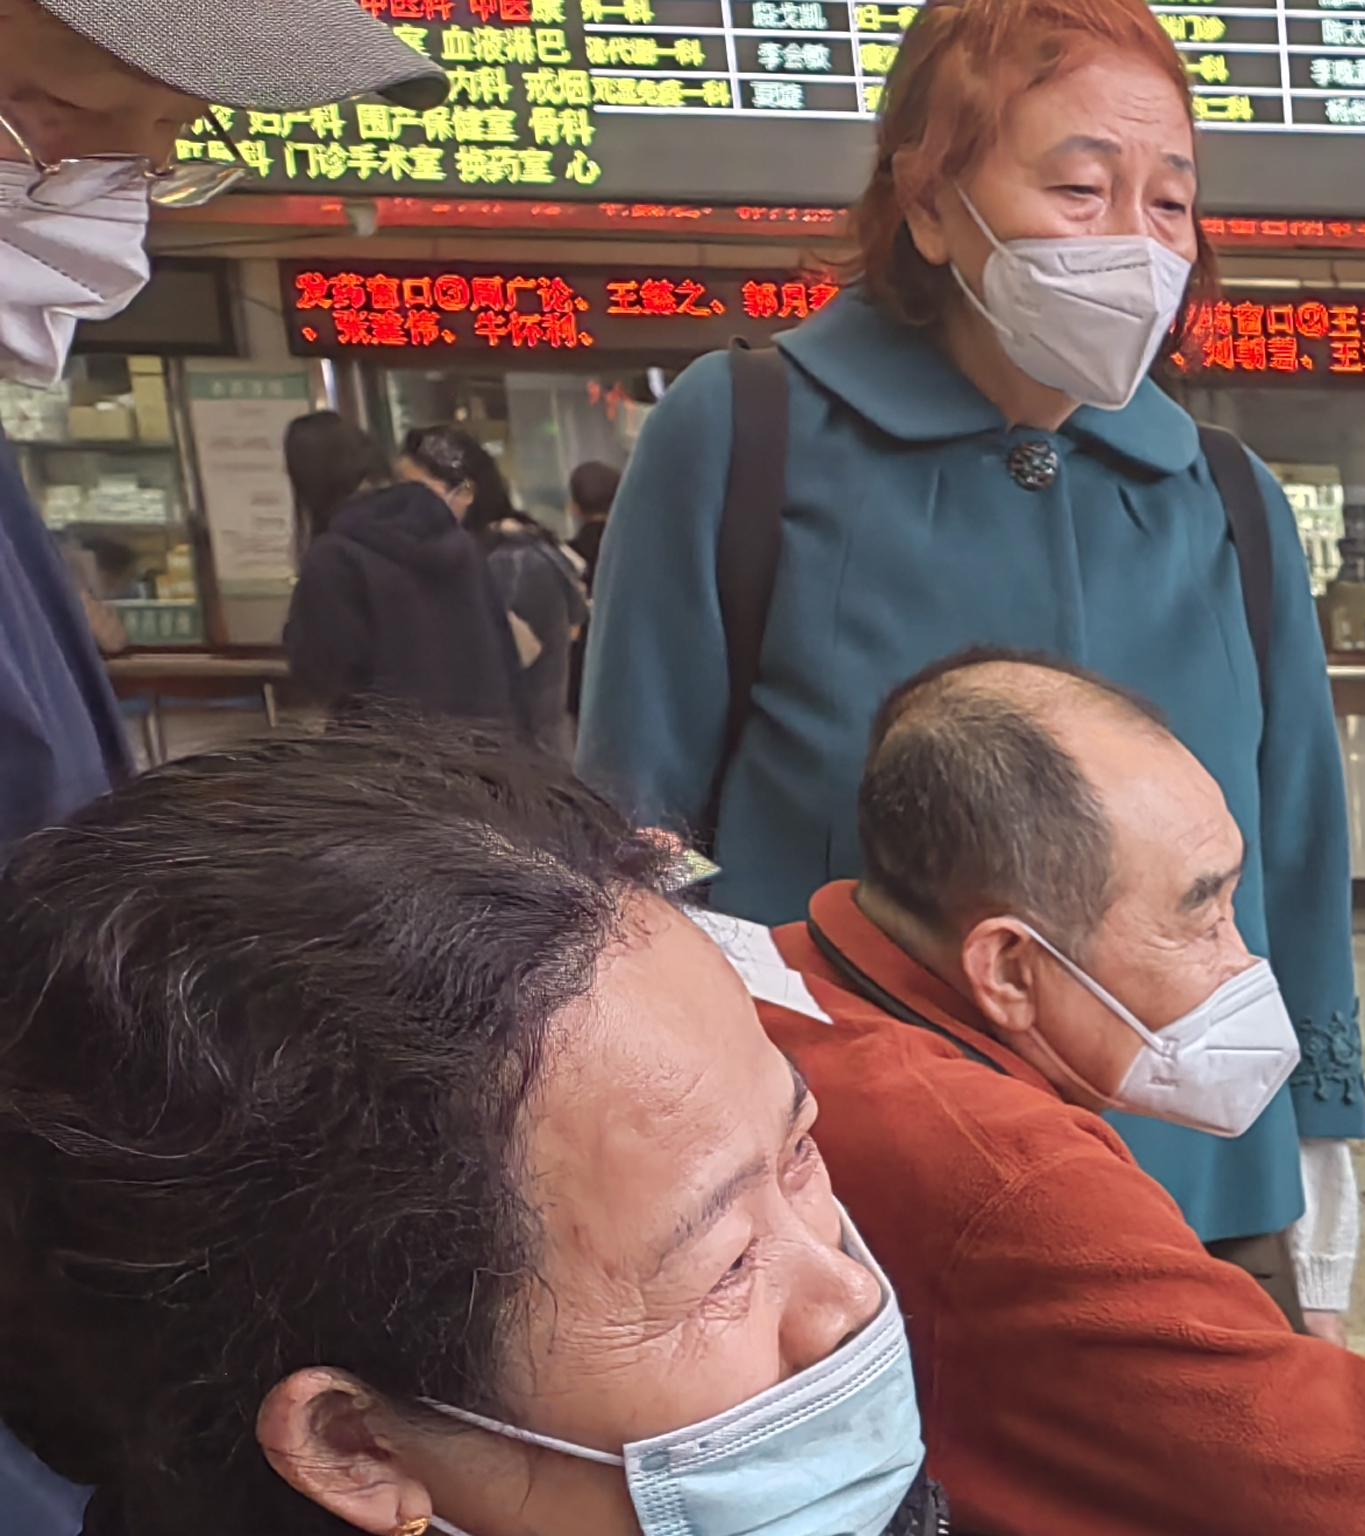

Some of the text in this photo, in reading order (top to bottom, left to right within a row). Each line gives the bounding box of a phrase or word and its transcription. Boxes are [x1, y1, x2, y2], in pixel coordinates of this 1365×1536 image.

[441, 24, 571, 64] 血液淋巴
[284, 141, 447, 181] 门诊手术室
